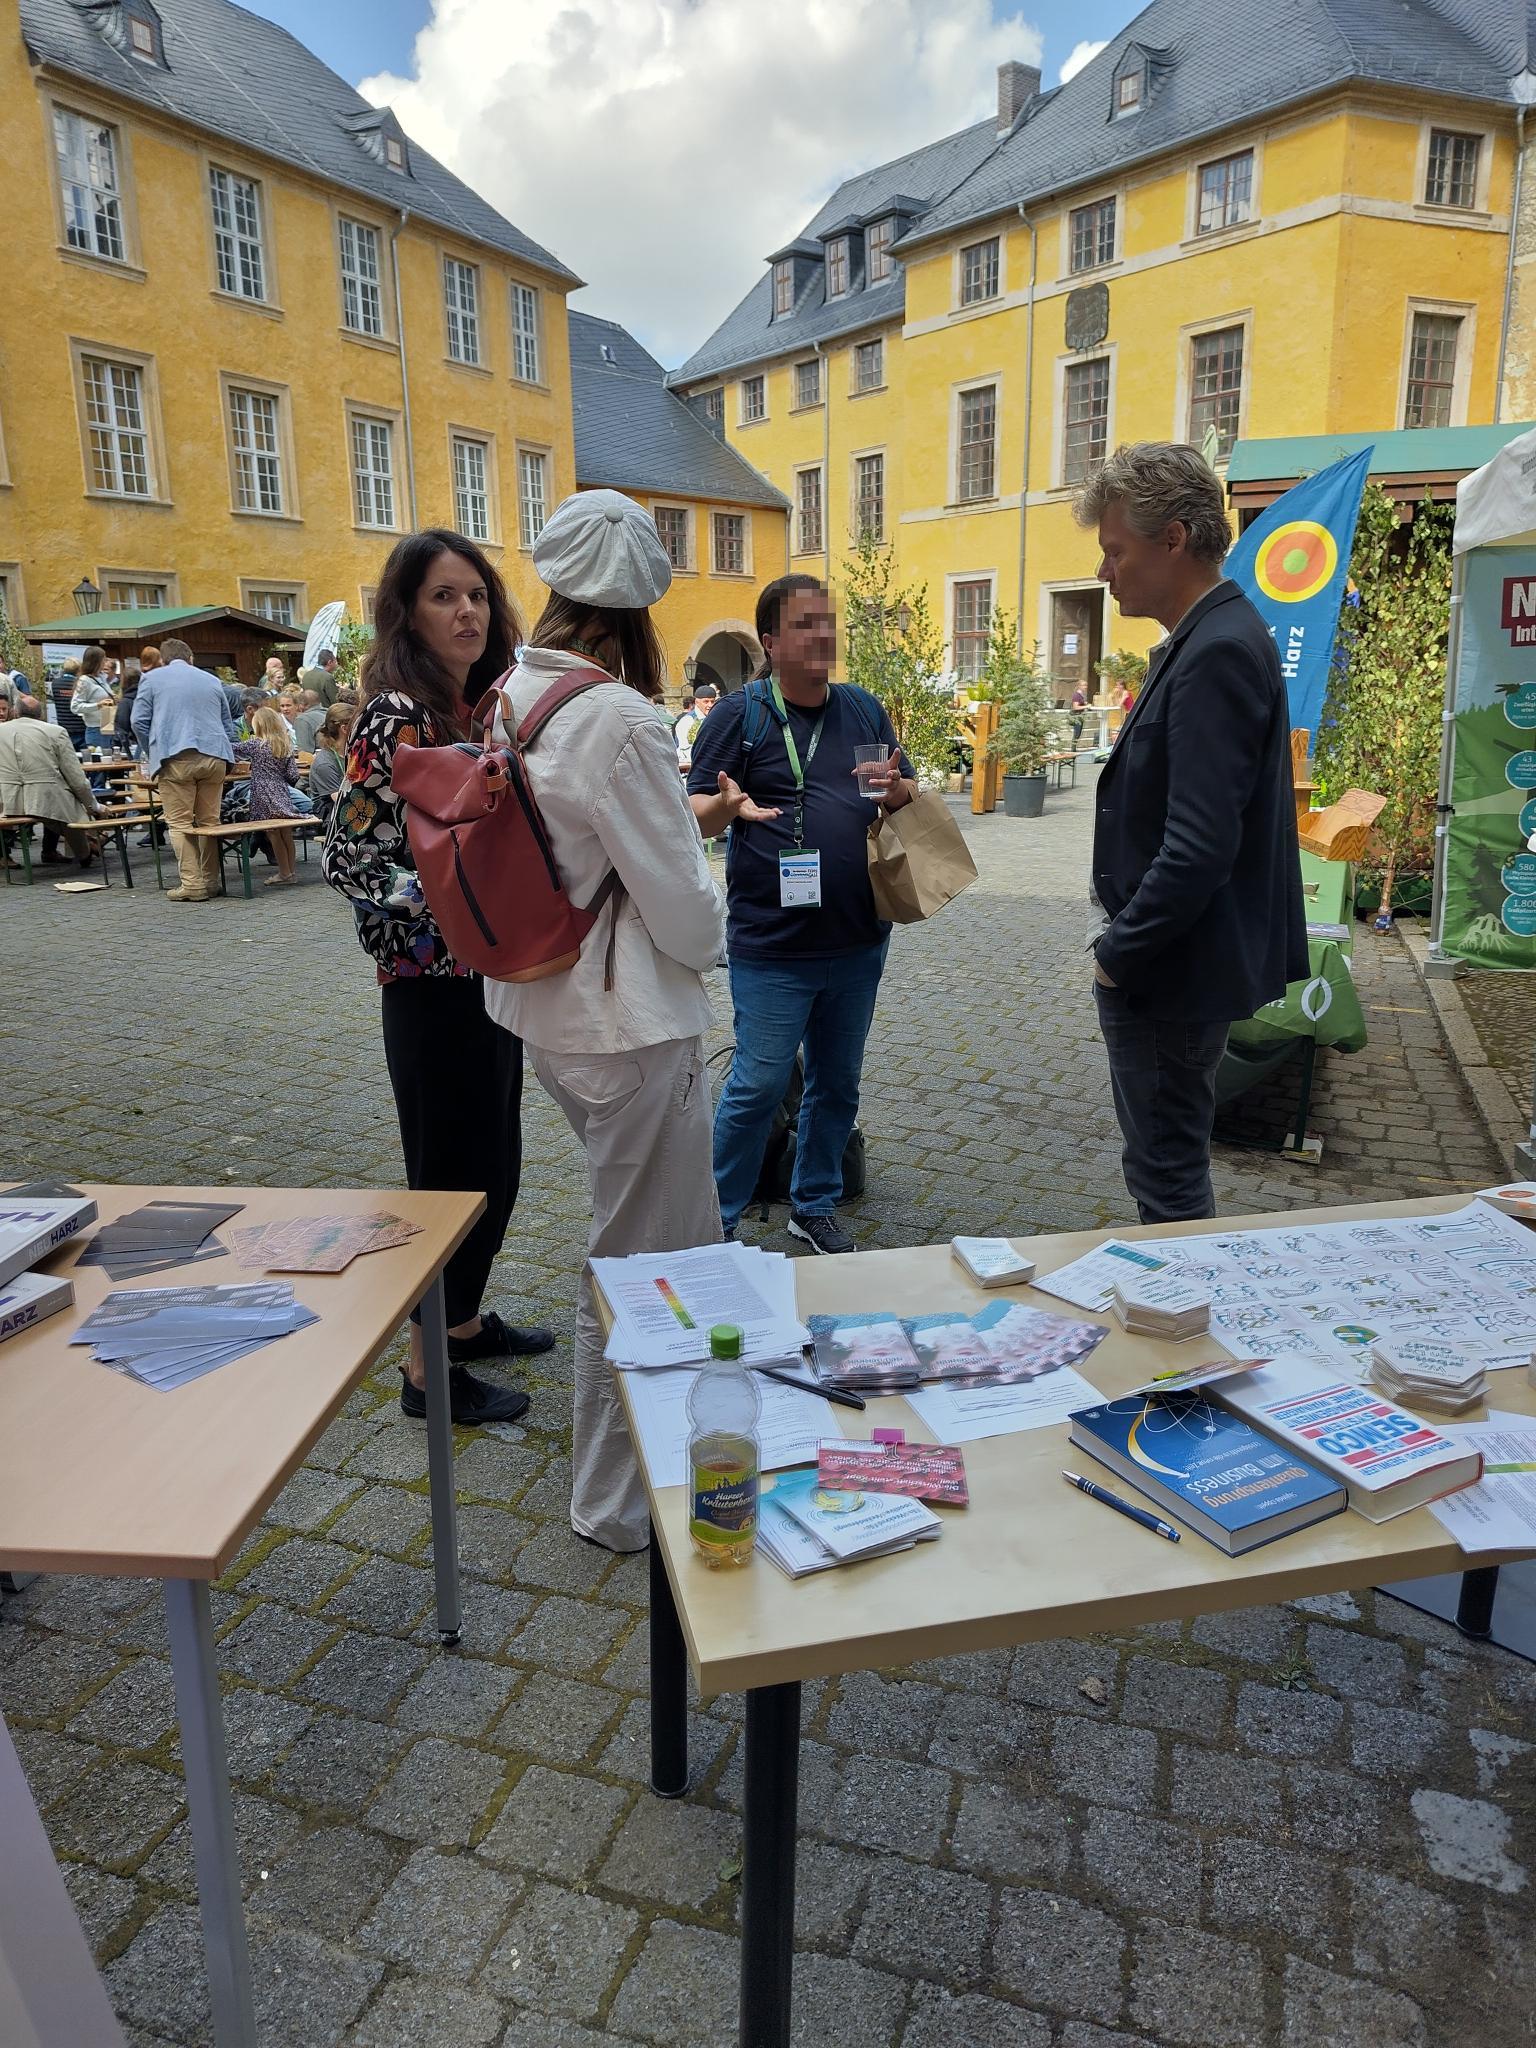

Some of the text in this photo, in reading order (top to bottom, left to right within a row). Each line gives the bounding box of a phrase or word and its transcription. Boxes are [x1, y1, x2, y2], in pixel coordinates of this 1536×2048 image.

[1281, 626, 1305, 678] Harz
[1518, 863, 1535, 871] 580
[1315, 1413, 1421, 1456] SEMCO
[1321, 1411, 1377, 1434] SYSTEM
[1186, 1453, 1292, 1495] im Business
[1202, 1467, 1309, 1508] Quantensprung
[715, 1491, 745, 1500] Harzer
